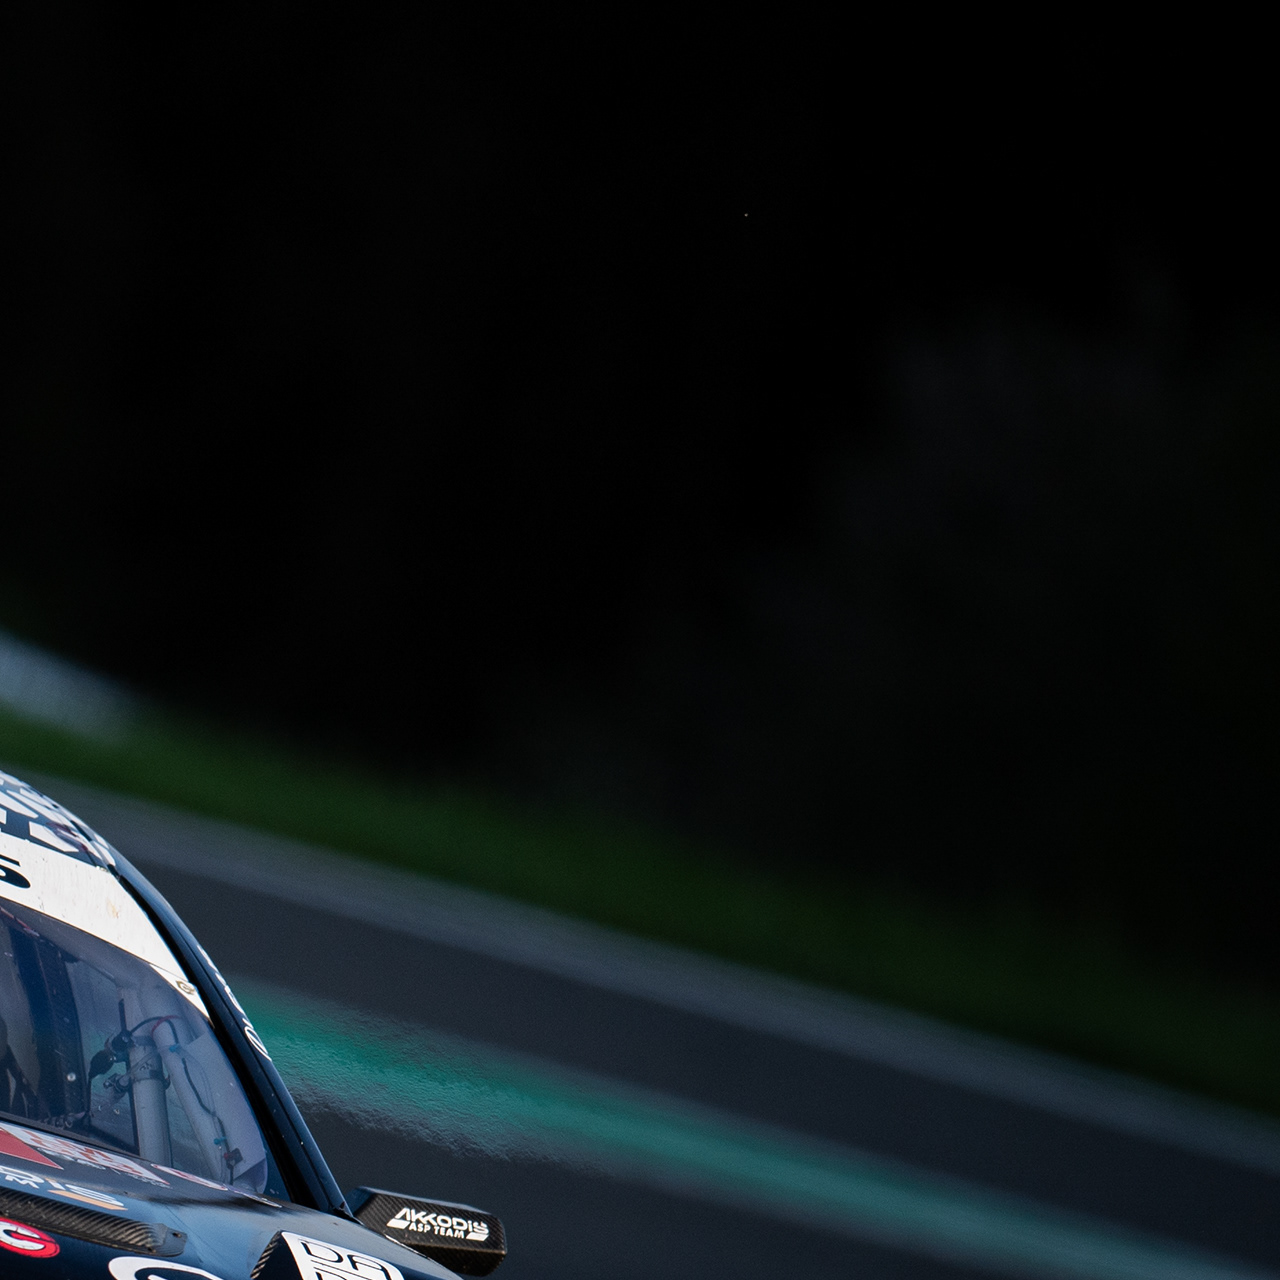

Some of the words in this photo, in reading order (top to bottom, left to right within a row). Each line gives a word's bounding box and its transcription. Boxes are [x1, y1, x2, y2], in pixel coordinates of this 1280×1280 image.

[395, 1207, 489, 1235] AKKODIS
[409, 1222, 436, 1234] ASP
[434, 1226, 466, 1240] TEAM
